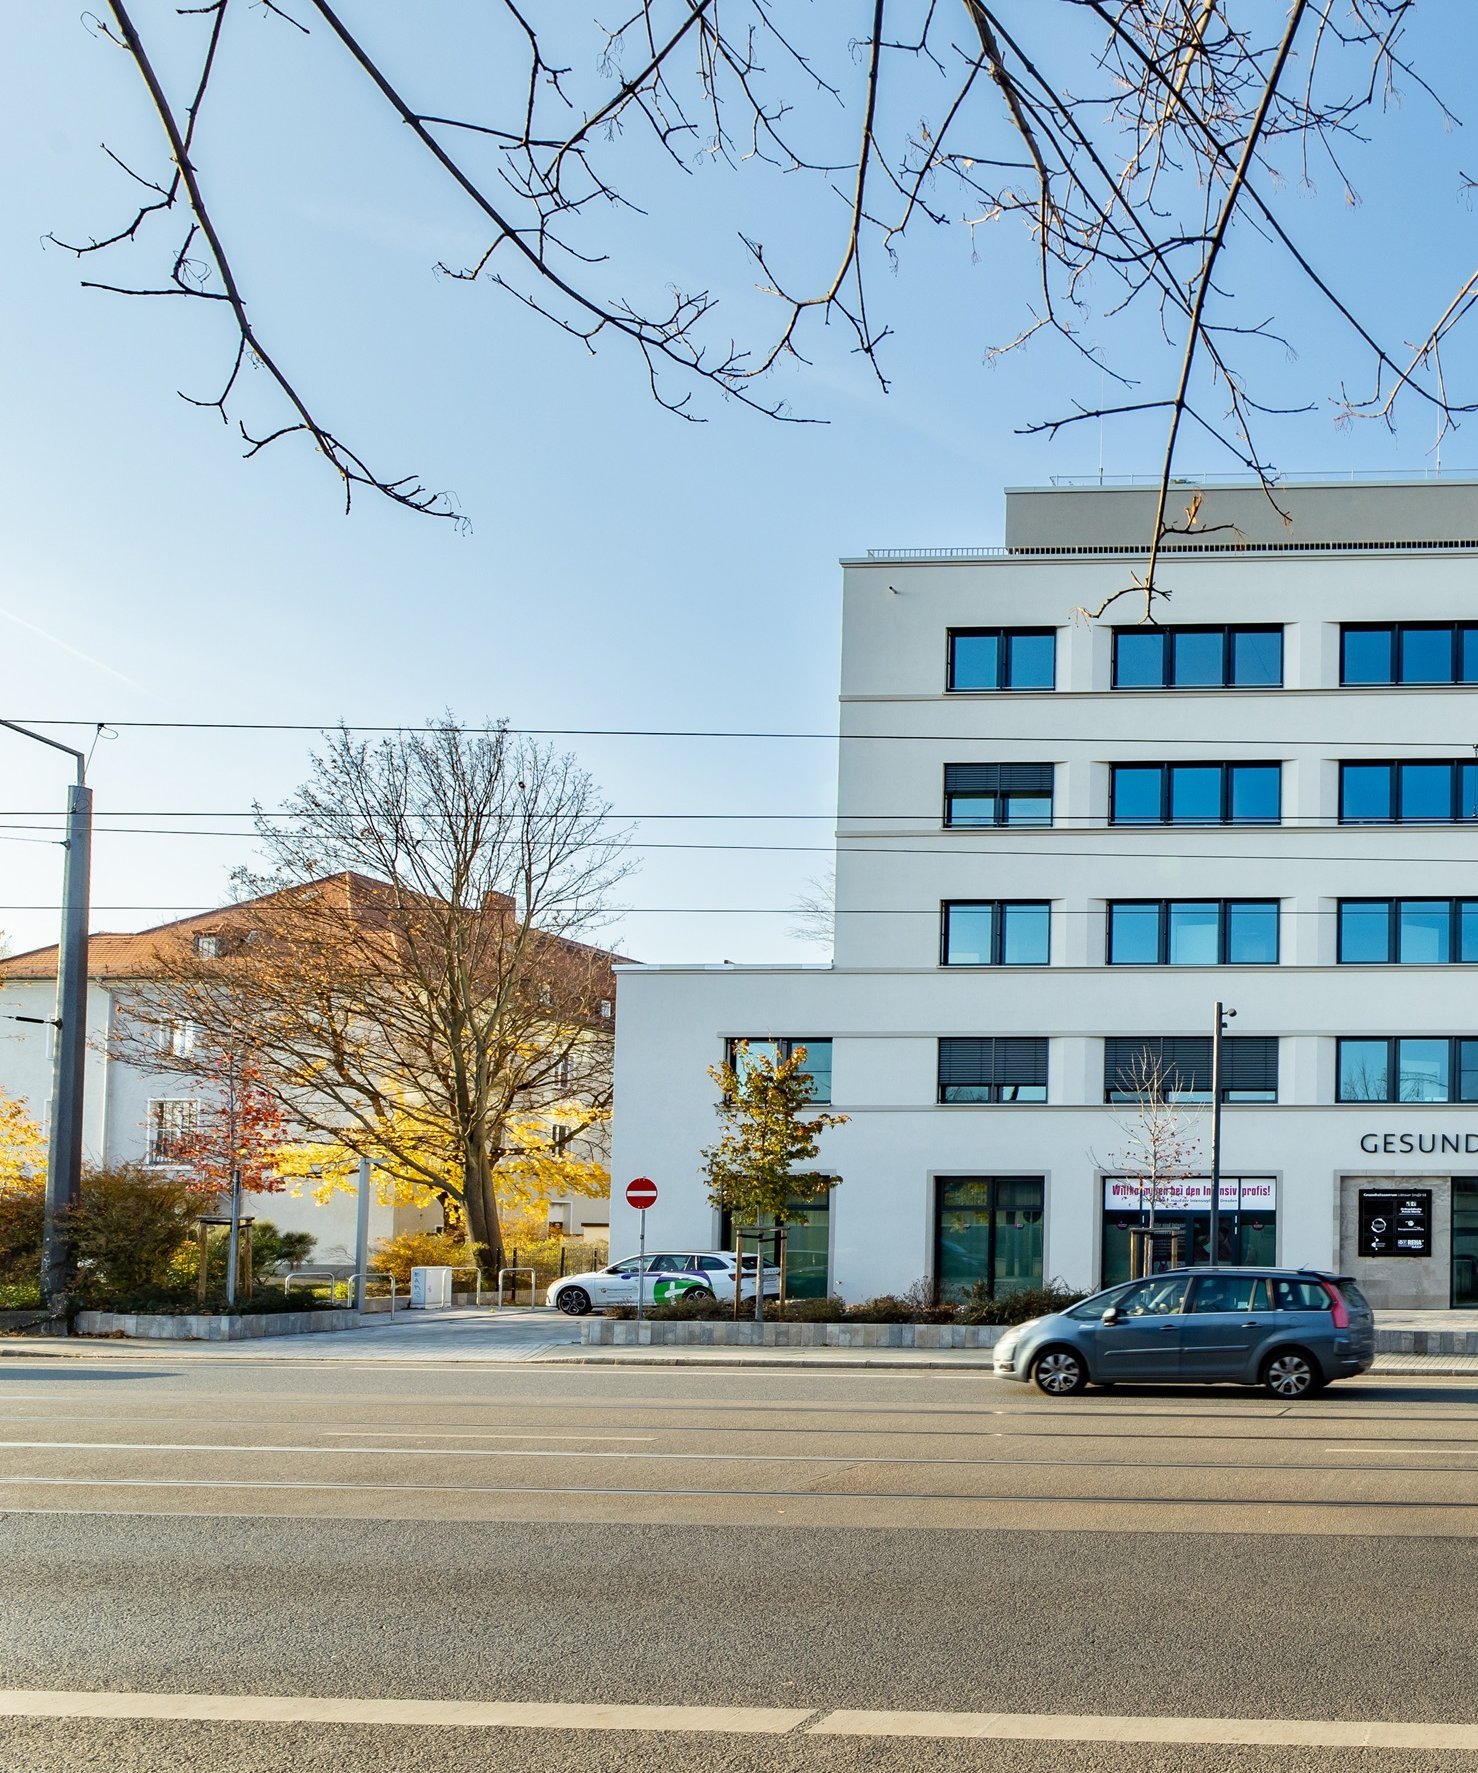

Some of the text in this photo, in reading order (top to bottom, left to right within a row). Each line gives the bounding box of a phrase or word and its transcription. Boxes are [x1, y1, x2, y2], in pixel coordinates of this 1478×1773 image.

[1112, 1185, 1168, 1196] Willkomen
[1170, 1185, 1183, 1196] bei
[1185, 1185, 1200, 1196] den
